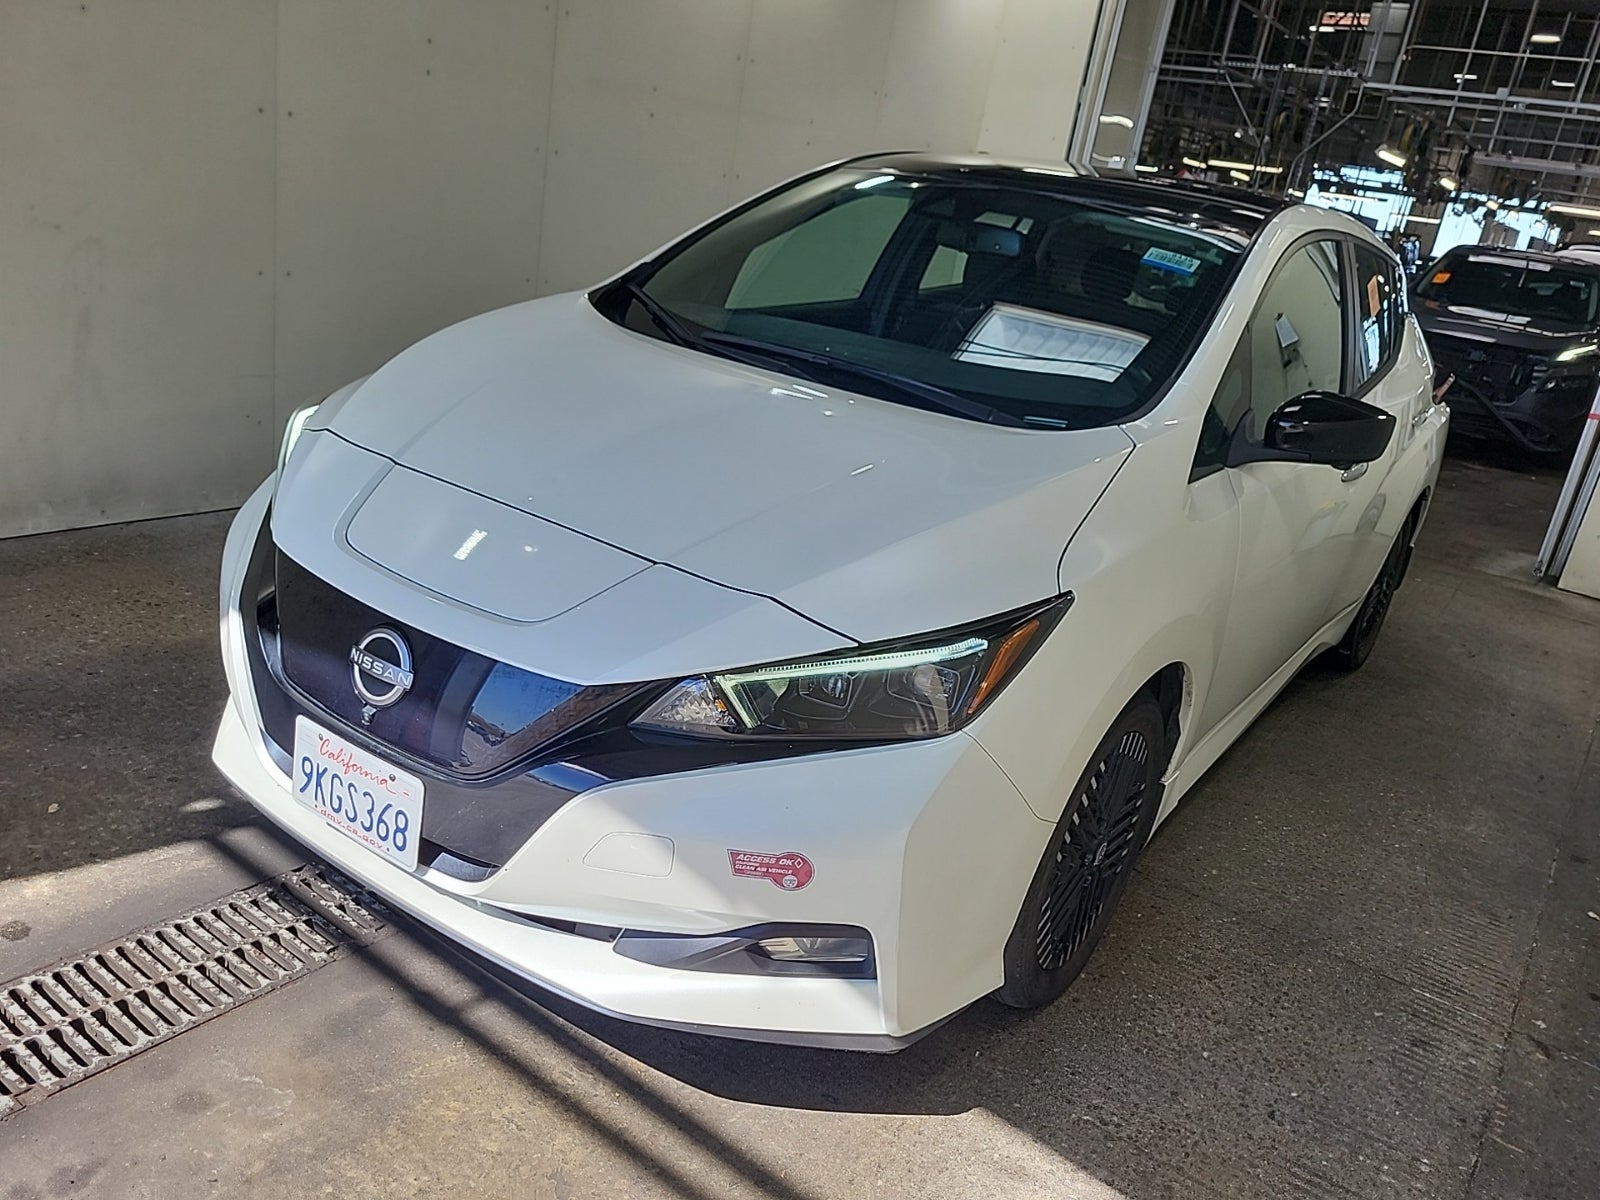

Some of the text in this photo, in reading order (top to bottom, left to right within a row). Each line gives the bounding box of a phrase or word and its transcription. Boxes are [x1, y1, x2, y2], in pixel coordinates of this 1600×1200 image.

[351, 647, 411, 686] NISSAN
[319, 738, 397, 795] California
[299, 755, 409, 852] 9KGS368
[736, 854, 777, 864] ACCESS
[779, 858, 795, 866] OK
[768, 867, 793, 875] VEHICLE
